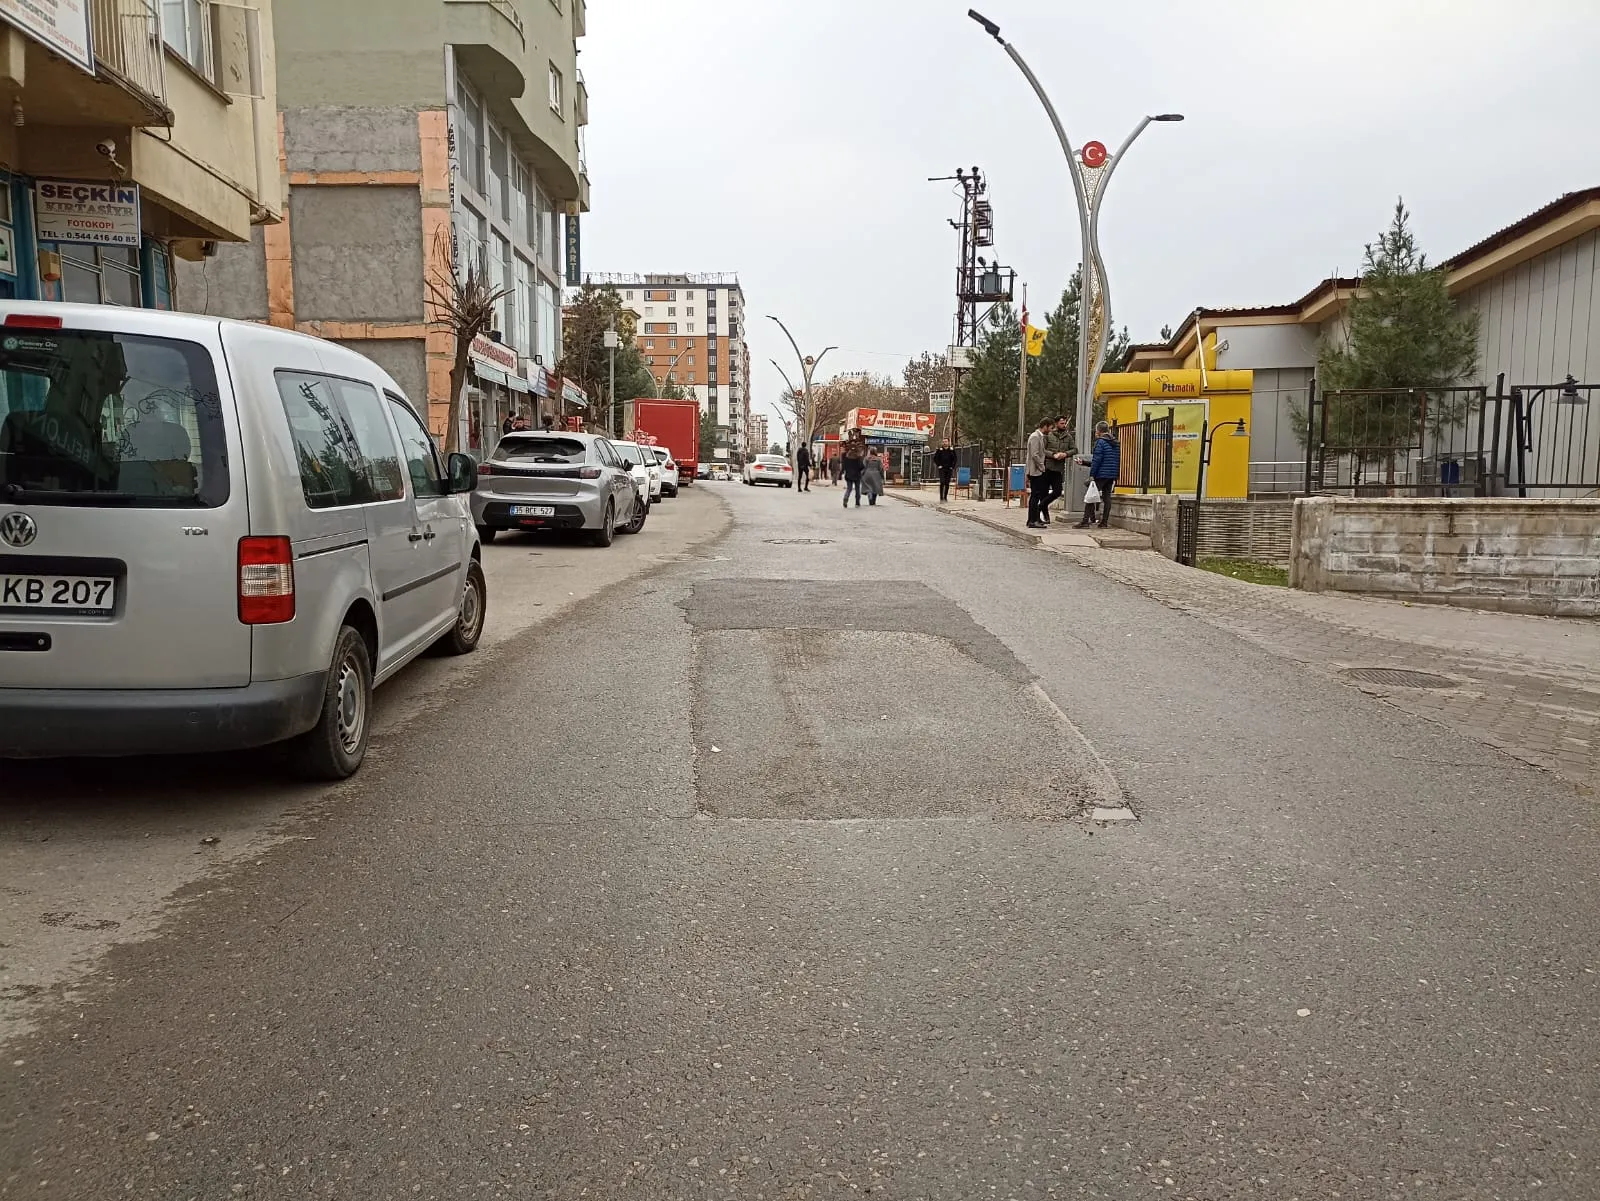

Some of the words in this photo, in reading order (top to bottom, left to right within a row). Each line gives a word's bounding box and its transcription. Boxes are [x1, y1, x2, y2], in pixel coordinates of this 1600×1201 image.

[41, 184, 134, 204] SEÇKİN
[42, 230, 59, 238] TEL
[569, 216, 577, 235] AK
[3, 578, 45, 604] KB
[51, 580, 112, 606] 207
